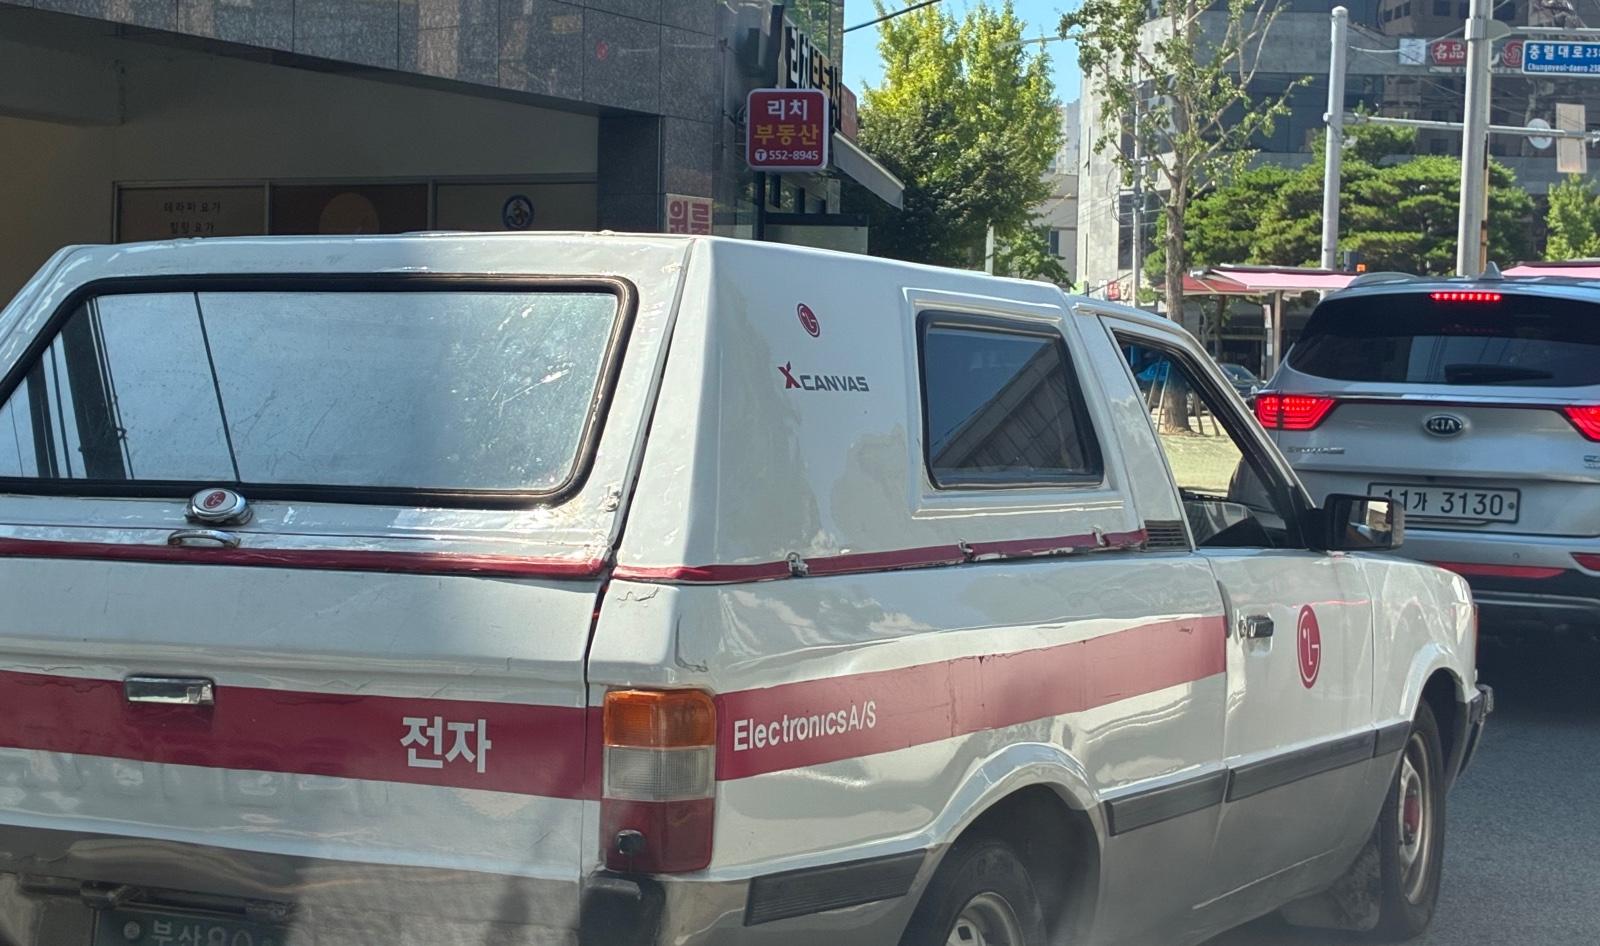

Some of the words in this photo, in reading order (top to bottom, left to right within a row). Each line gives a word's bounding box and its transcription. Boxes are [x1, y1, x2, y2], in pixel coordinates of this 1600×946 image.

[1528, 44, 1583, 60] 충렬대로
[1586, 48, 1600, 58] 23
[767, 99, 808, 120] 리치
[754, 124, 819, 145] 부동산
[769, 150, 819, 160] 552-8945
[1428, 418, 1459, 432] KIA
[1440, 491, 1504, 516] 3130
[400, 716, 492, 773] 전자
